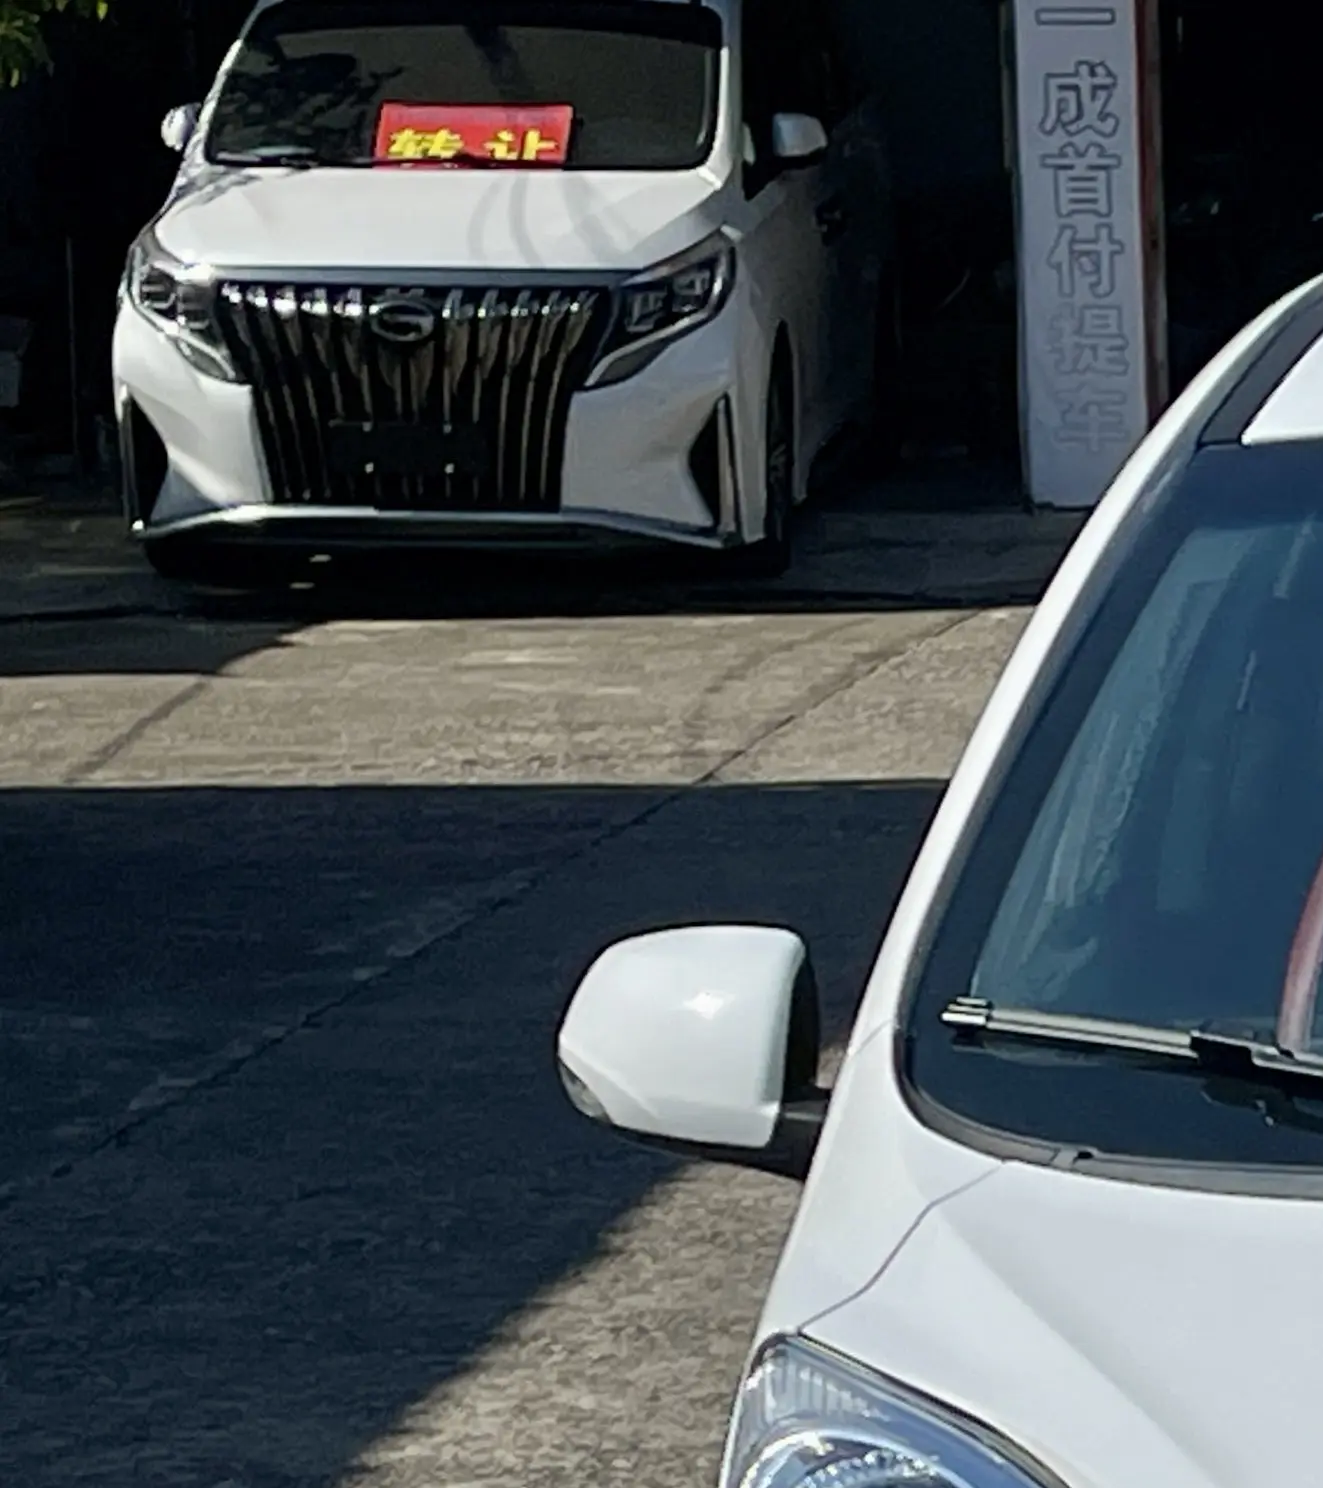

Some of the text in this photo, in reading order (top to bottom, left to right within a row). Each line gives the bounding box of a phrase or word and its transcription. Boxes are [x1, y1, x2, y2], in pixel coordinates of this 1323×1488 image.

[1035, 7, 1131, 455] 一成首付提车
